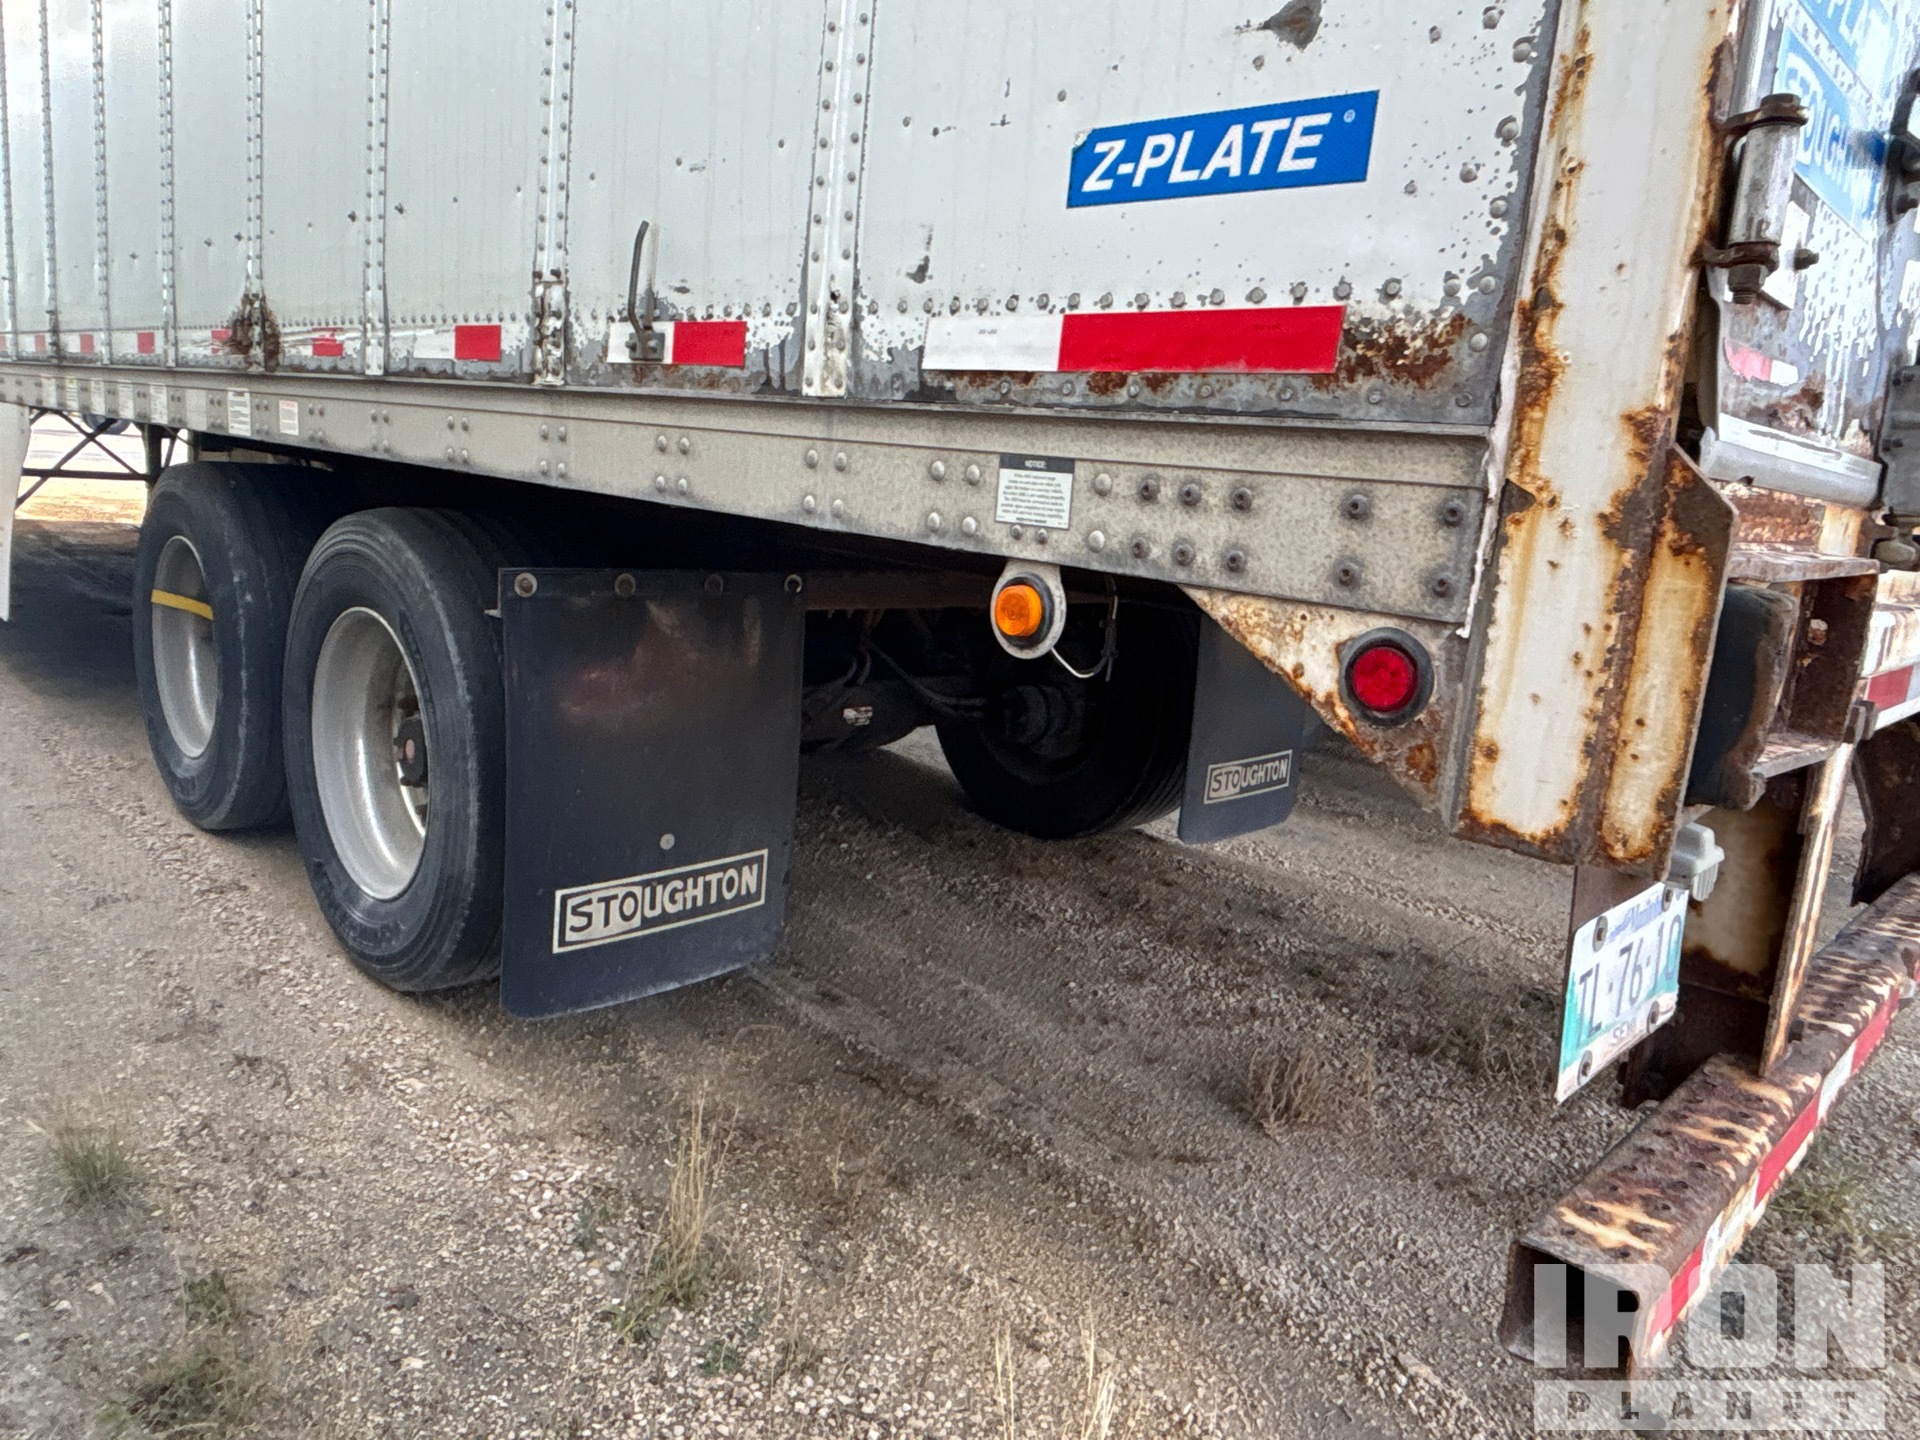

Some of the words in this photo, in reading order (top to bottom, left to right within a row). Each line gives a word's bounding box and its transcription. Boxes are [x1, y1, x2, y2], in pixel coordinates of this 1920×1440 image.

[1081, 112, 1332, 193] Z-PLATE
[1211, 758, 1289, 793] STOUGHTON
[568, 863, 759, 933] STOUGHTON
